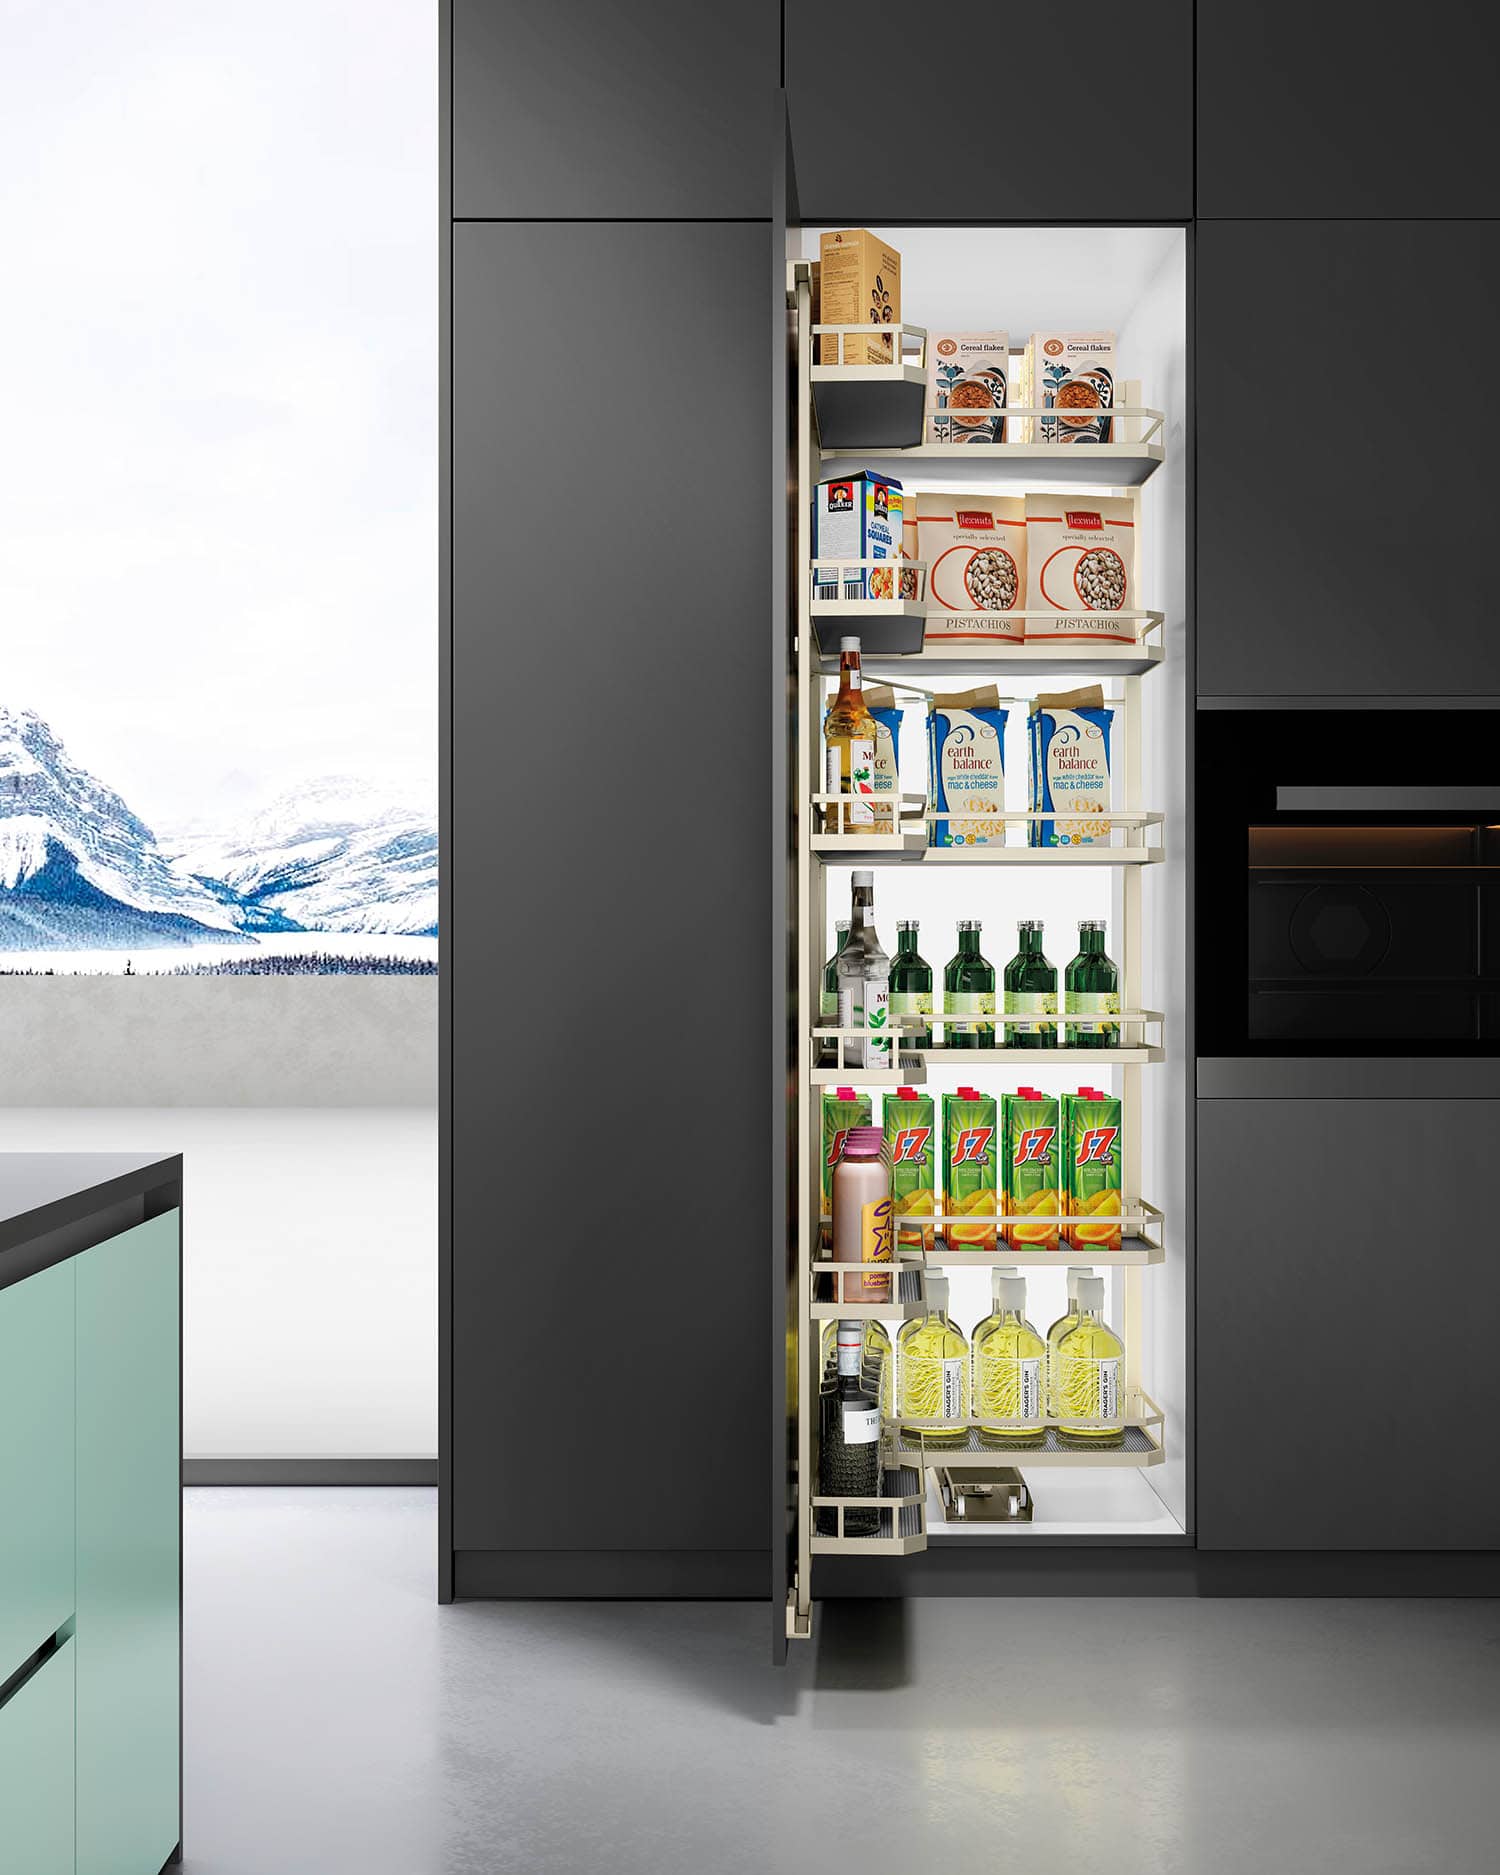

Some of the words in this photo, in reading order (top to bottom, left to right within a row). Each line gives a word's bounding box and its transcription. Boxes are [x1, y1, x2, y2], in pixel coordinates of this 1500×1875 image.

[829, 501, 853, 510] QUAKER
[867, 528, 893, 545] SQUARES
[946, 619, 1011, 630] PISTACHIOS
[1055, 619, 1120, 630] PISTACHIOS
[947, 746, 974, 757] earth
[1053, 746, 1080, 757] earth
[953, 758, 992, 769] balance
[1058, 758, 1098, 769] balance
[874, 781, 892, 789] eese
[948, 781, 963, 789] mac
[965, 781, 970, 789] &
[970, 780, 998, 789] cheese
[1053, 781, 1069, 789] mac
[1070, 781, 1075, 789] &
[1076, 780, 1104, 789] cheese
